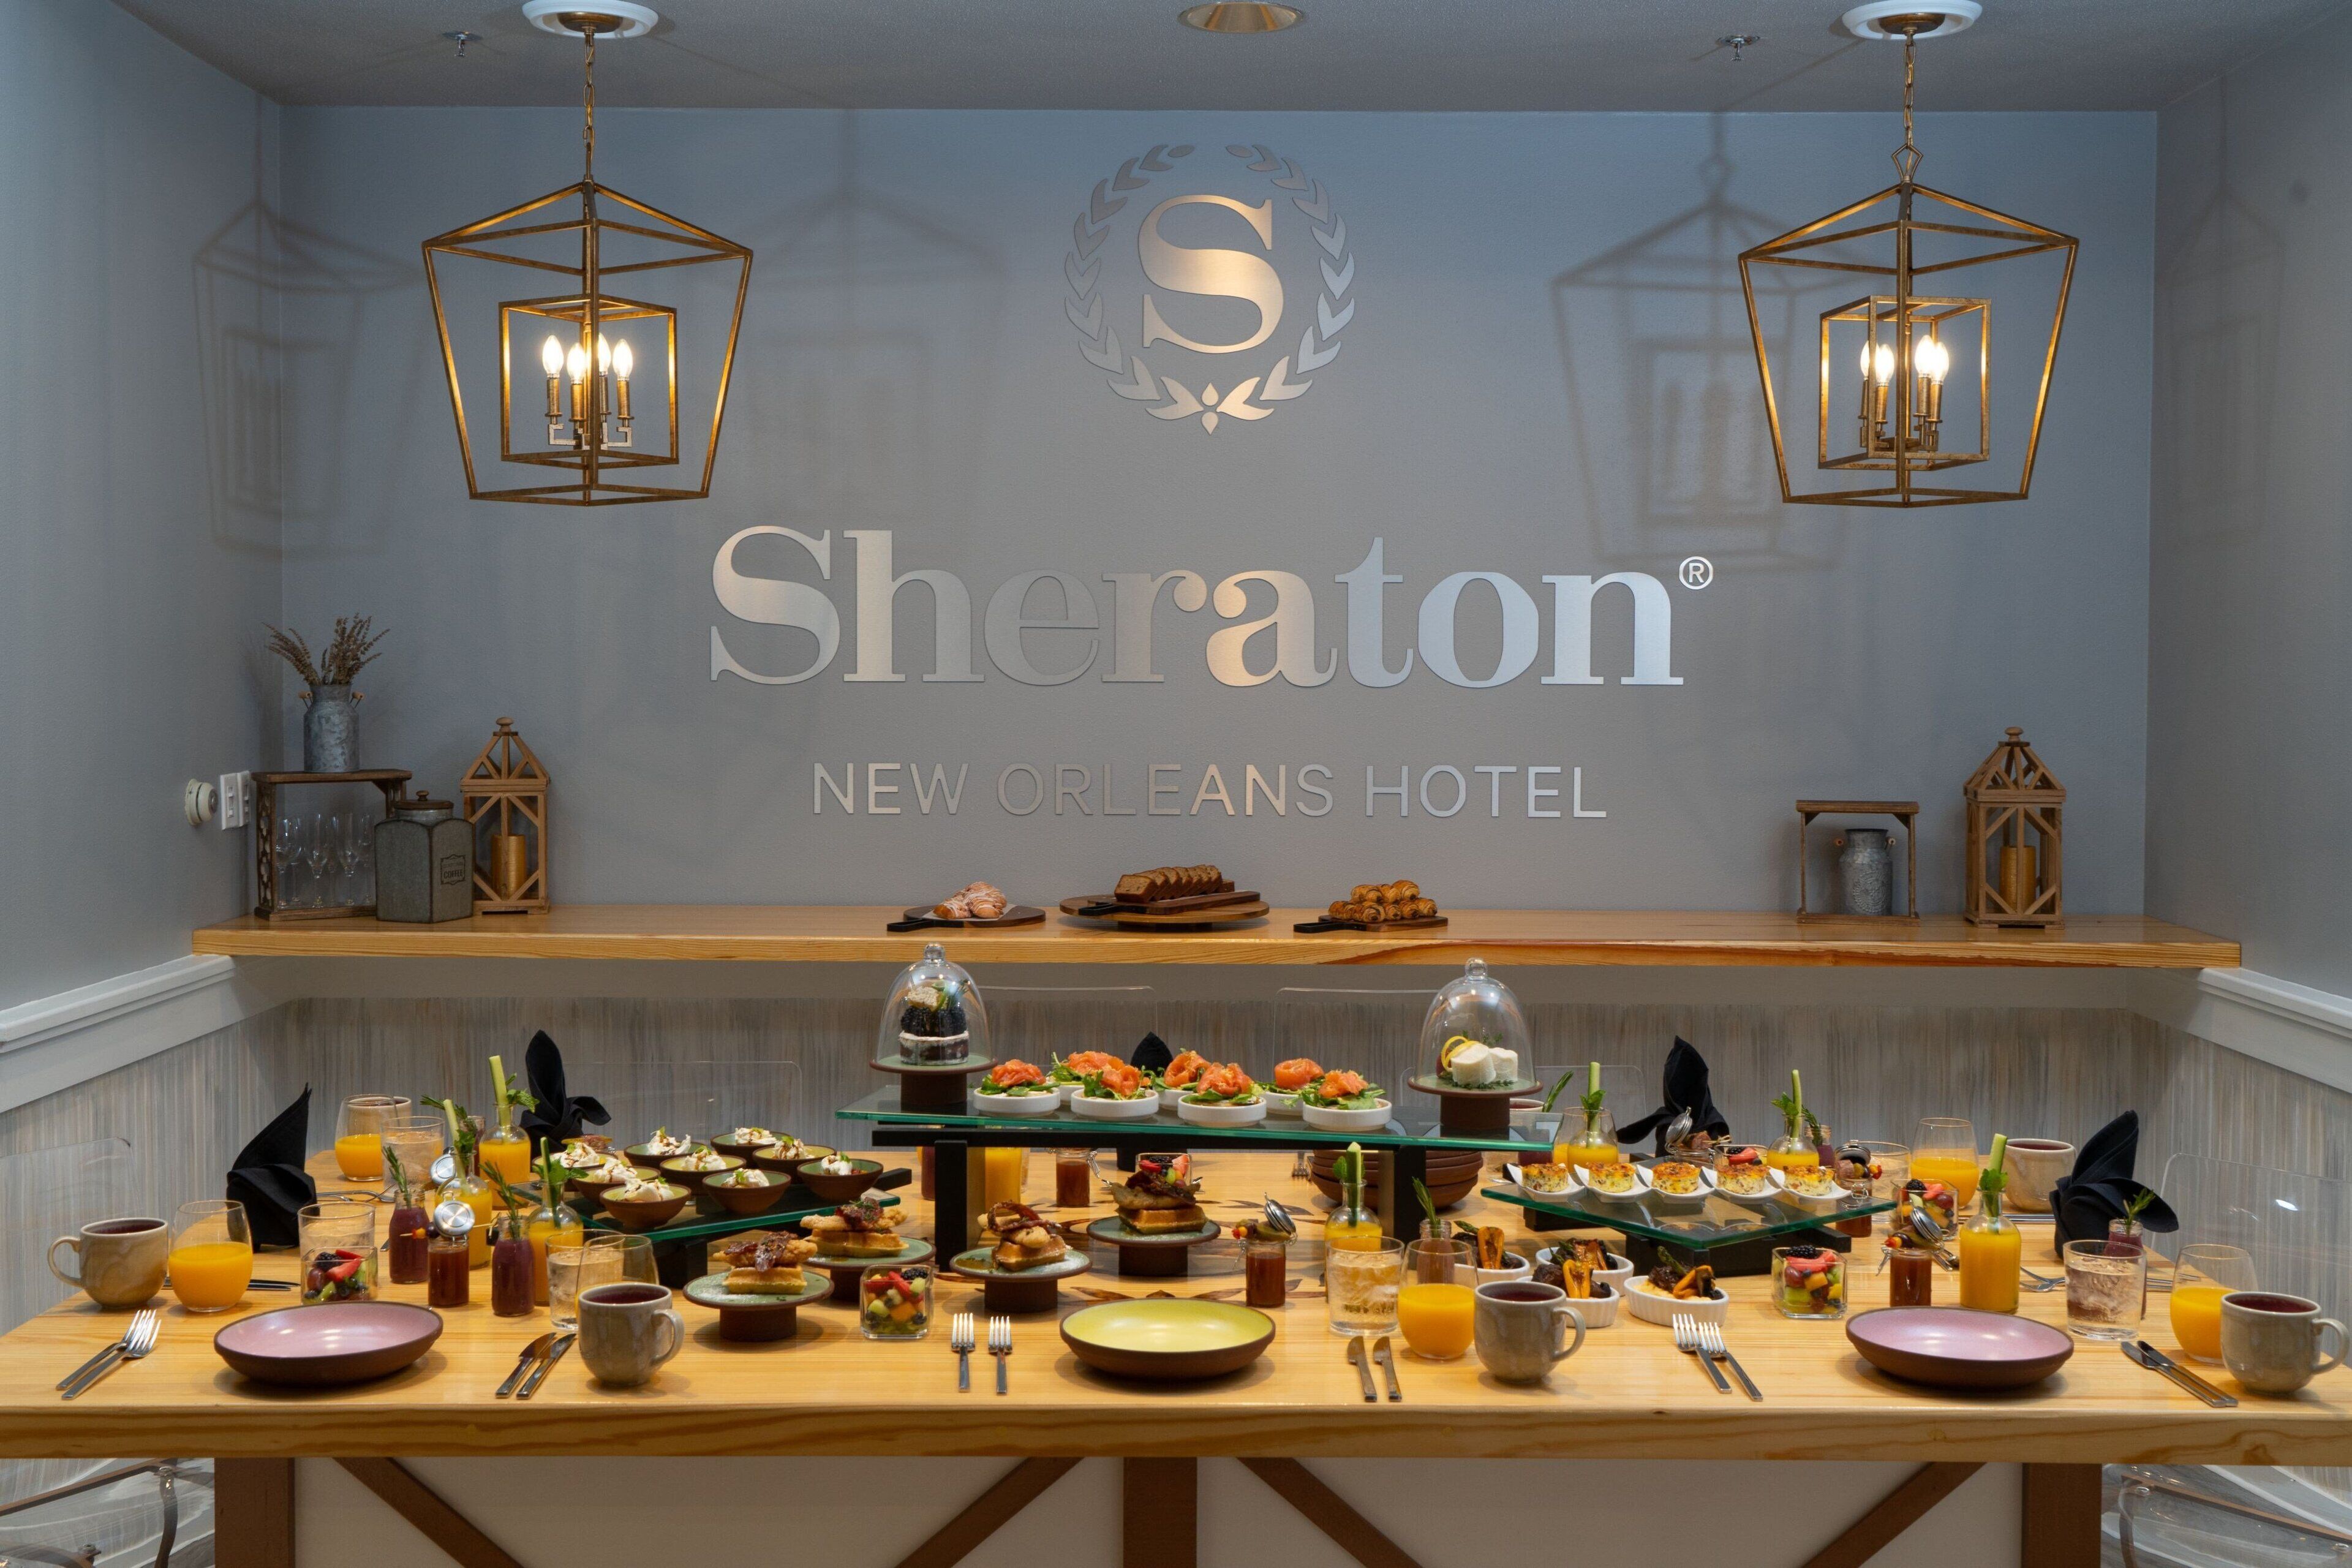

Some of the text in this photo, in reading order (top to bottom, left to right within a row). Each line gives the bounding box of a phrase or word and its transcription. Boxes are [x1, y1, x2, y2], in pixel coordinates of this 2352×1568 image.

[1138, 194, 1284, 354] S
[813, 762, 1607, 818] NEW ORLEANS HOTEL
[443, 869, 463, 879] COFFEE
